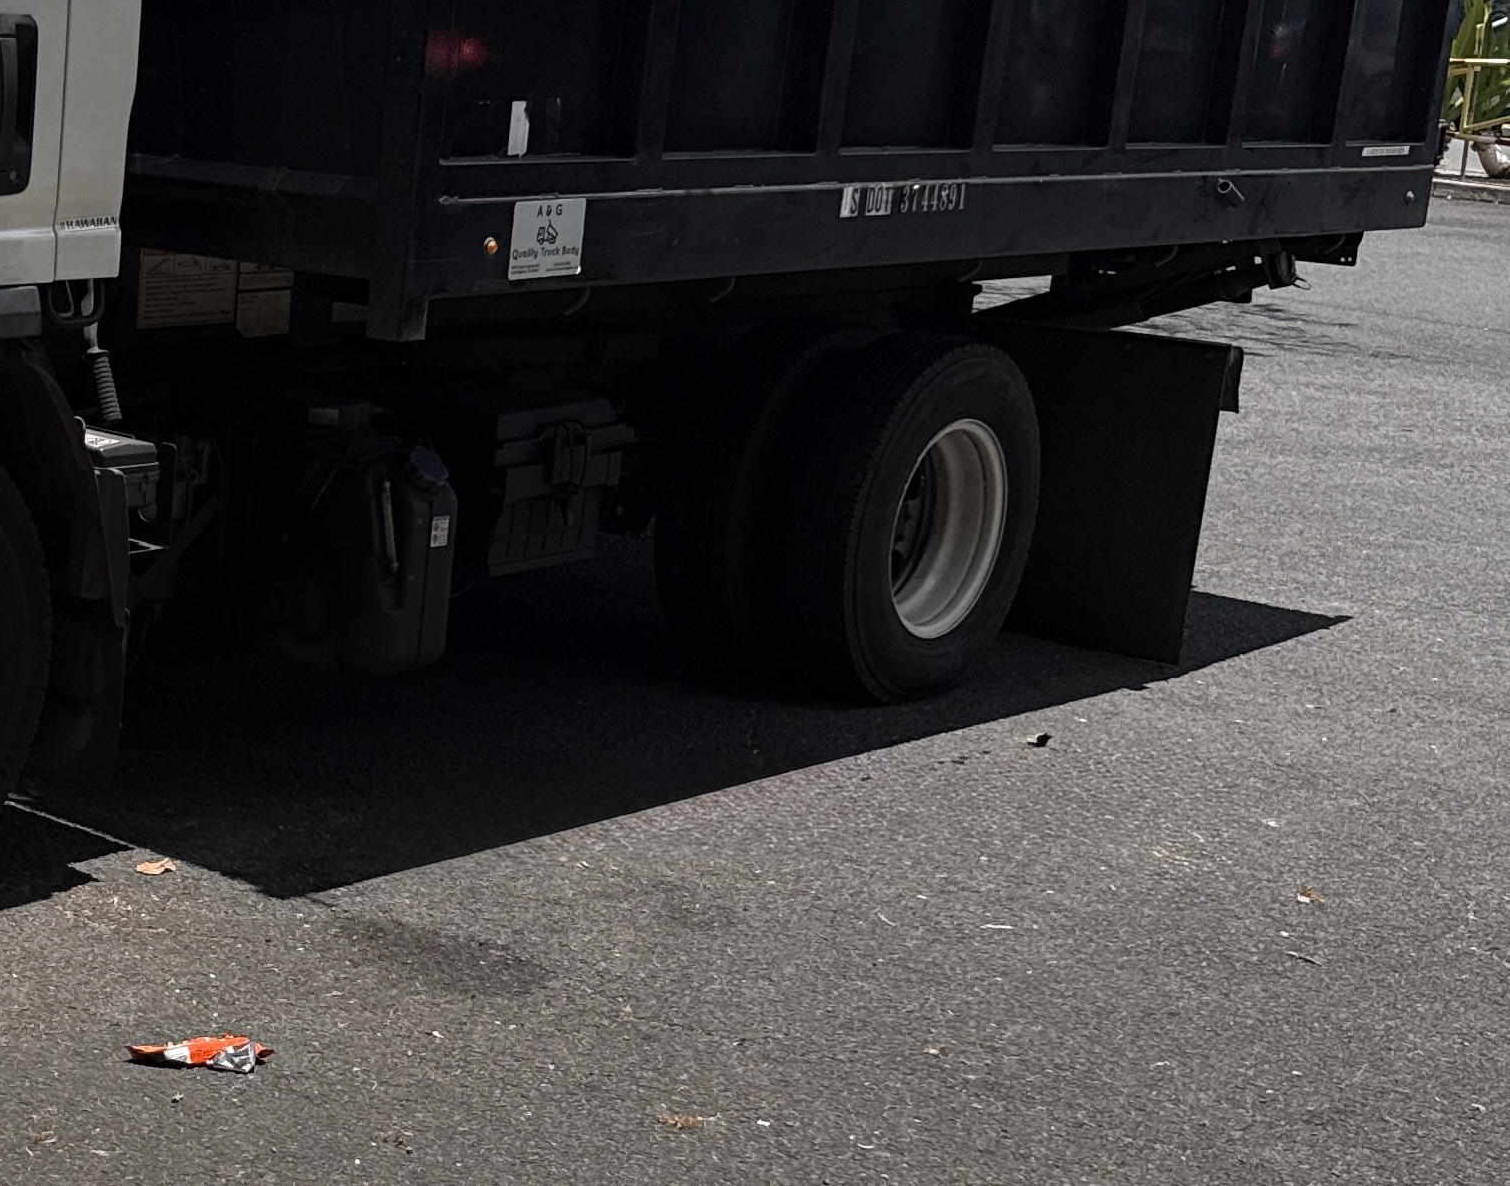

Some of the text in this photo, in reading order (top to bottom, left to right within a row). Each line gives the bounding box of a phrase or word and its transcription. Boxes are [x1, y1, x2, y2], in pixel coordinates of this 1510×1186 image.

[865, 185, 894, 215] DOT
[900, 183, 966, 213] 3744891
[536, 205, 543, 217] A
[556, 204, 563, 216] G
[512, 245, 580, 260] Quality Truck Body
